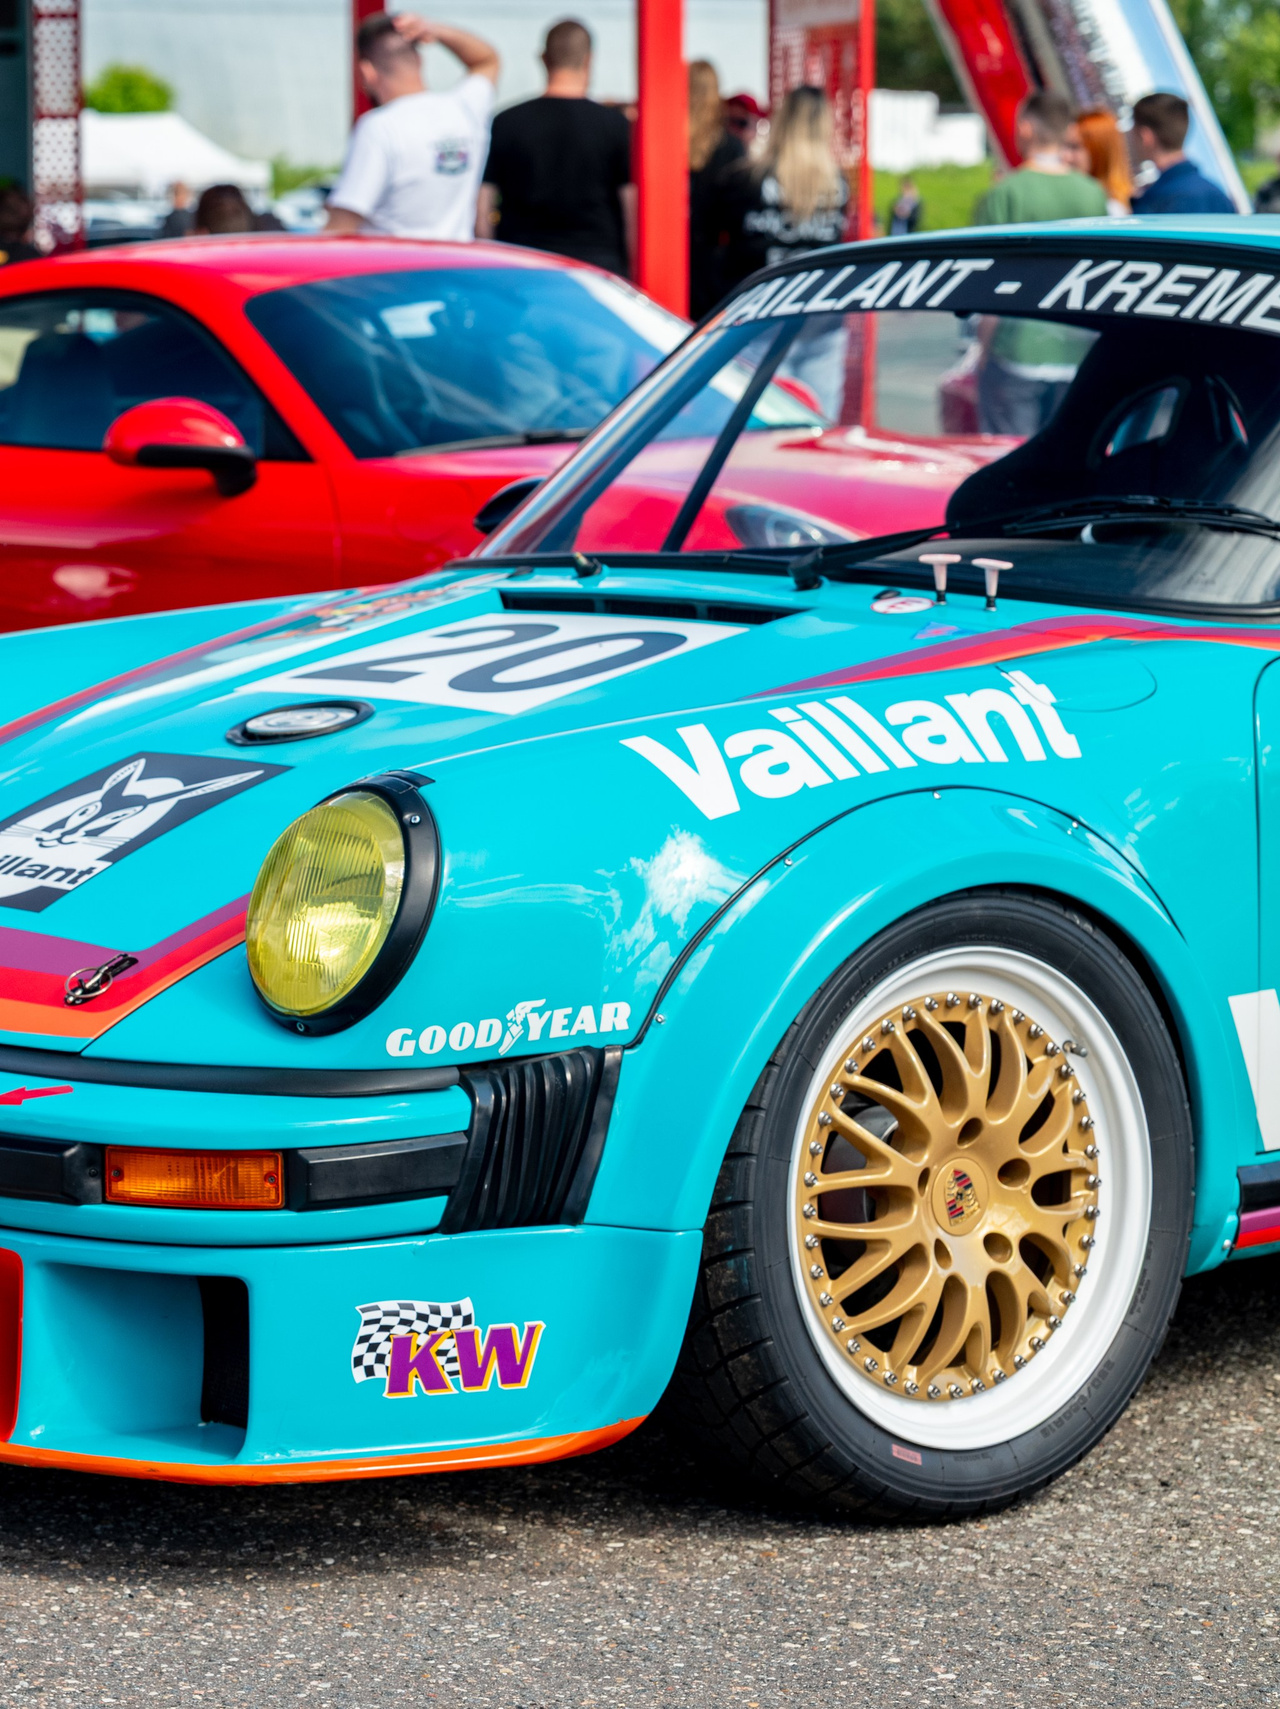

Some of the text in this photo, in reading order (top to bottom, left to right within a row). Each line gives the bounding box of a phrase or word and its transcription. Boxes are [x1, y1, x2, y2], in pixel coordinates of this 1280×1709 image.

[292, 623, 688, 692] 20
[619, 670, 1083, 820] Vaillant
[382, 1321, 547, 1399] KW
